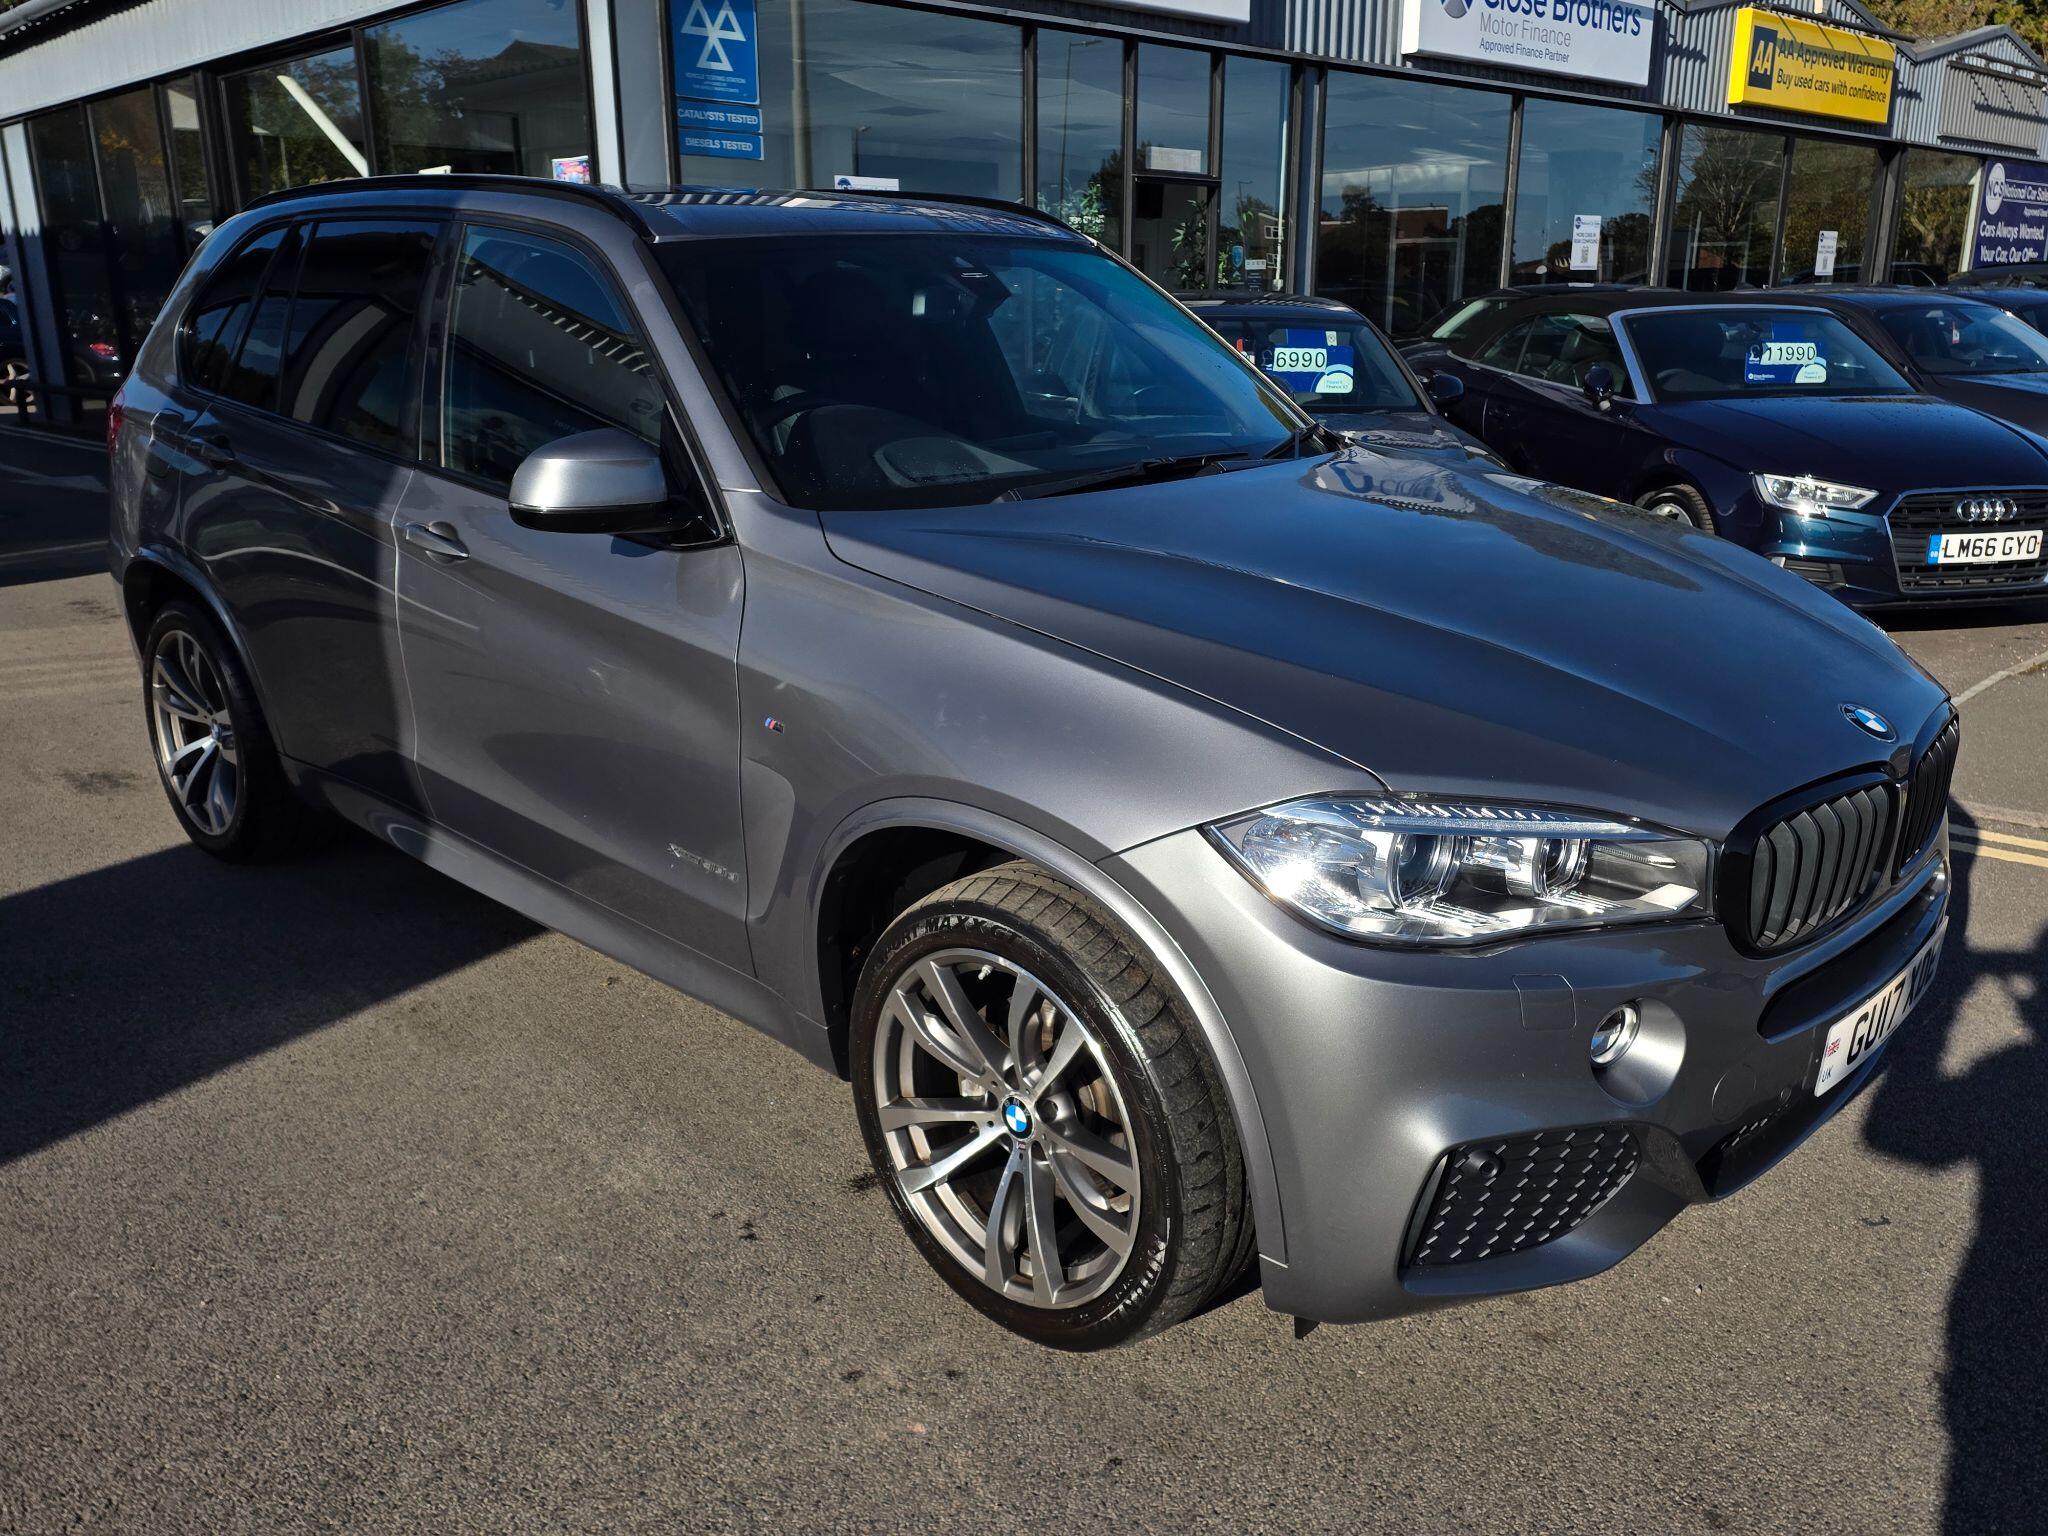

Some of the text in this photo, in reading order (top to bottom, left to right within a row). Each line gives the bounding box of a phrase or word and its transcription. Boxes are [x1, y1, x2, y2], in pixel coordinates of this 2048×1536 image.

[1480, 11, 1571, 47] Motor Finance
[1552, 0, 1642, 37] Brothers
[1479, 37, 1569, 63] Approved Finance Partner
[1751, 39, 1774, 76] AA
[1778, 38, 1891, 84] AA Approved Warranty
[1776, 68, 1887, 103] Buy used cars with confidence
[677, 108, 759, 125] CATALYSTS TESTED
[685, 137, 753, 152] DIESELS TESTED
[1980, 219, 1995, 238] Cars
[1995, 221, 2019, 242] Always
[1943, 535, 2038, 559] LM66 GYO
[1847, 977, 1906, 1066] GU17
